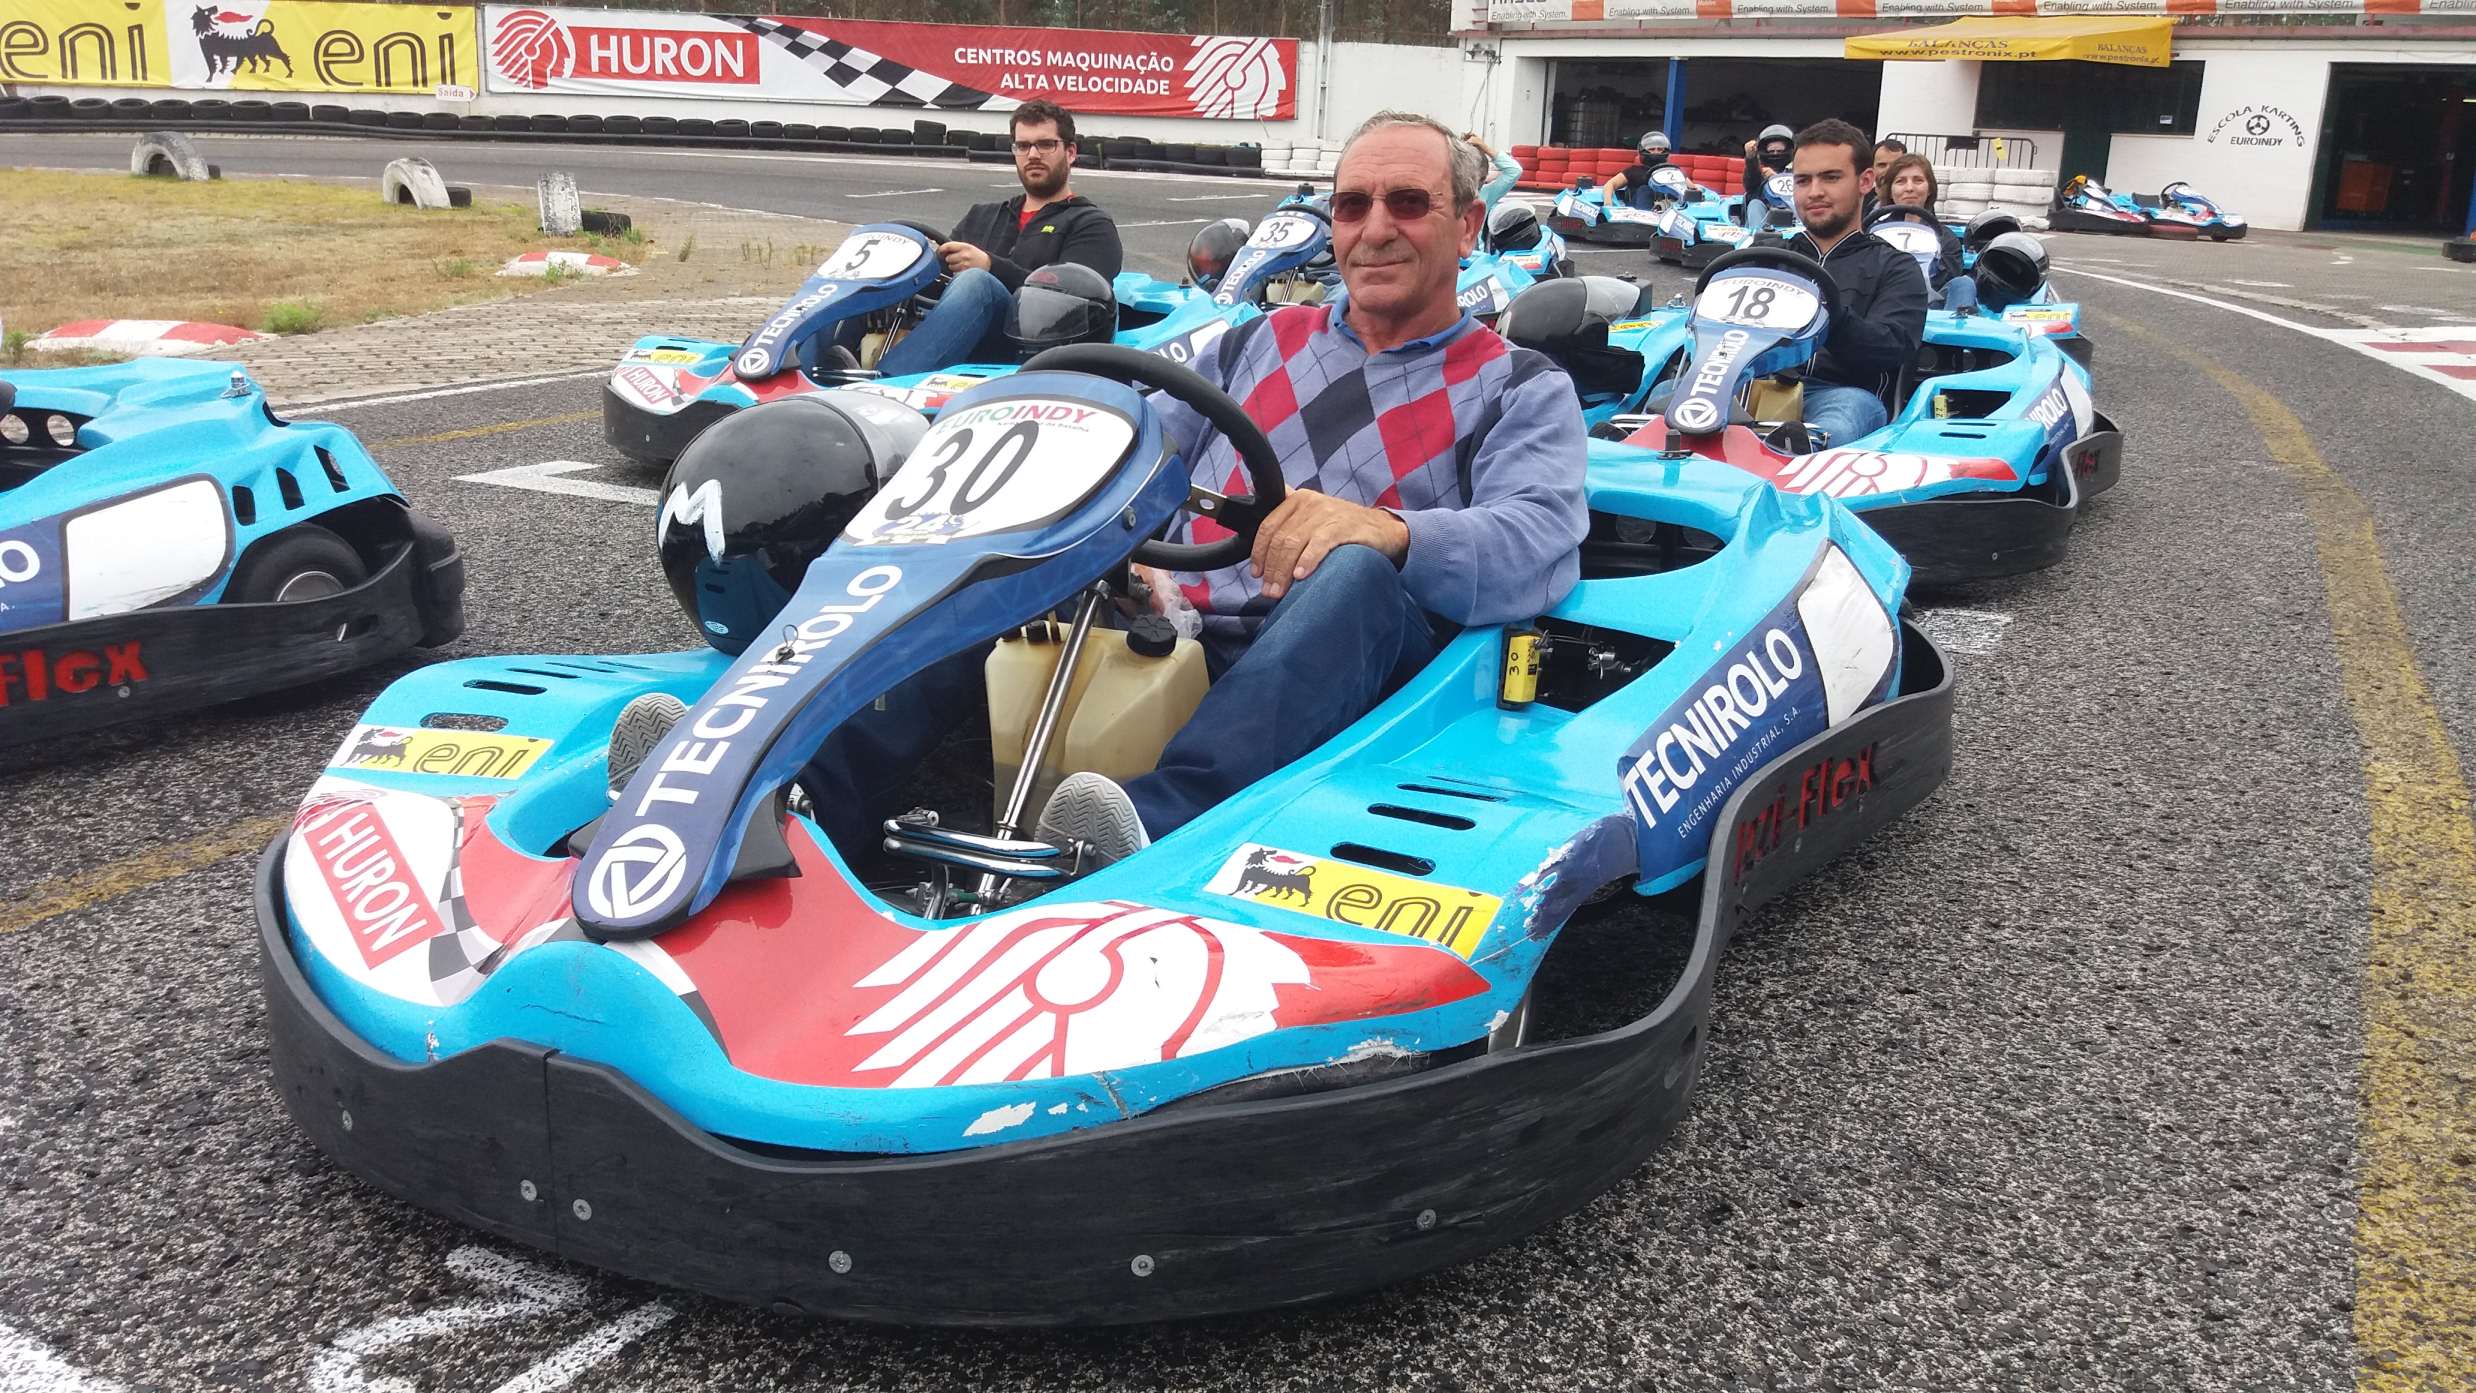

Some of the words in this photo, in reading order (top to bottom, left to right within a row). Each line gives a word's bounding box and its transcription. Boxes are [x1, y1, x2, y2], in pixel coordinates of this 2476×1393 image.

[1609, 8, 1640, 17] Enabling
[1738, 4, 1773, 15] Enabling
[1882, 3, 1922, 13] Enabling
[2044, 1, 2089, 11] Enabling
[2092, 1, 2113, 10] with
[0, 2, 147, 81] eni
[313, 12, 456, 88] eni
[590, 33, 744, 78] HURON
[1880, 48, 2038, 59] www.pestronix.pt
[954, 47, 1042, 66] CENTROS
[1046, 51, 1174, 74] MAQUINAÇÃO
[1000, 73, 1049, 91] ALTA
[1053, 75, 1170, 95] VELOCIDADE
[2208, 106, 2252, 143] ESCOLA
[2261, 105, 2305, 147] KARTING
[2230, 136, 2283, 146] EUROINDY
[1260, 222, 1294, 242] 35
[1897, 233, 1911, 249] 7
[845, 240, 880, 272] 5
[1728, 285, 1775, 320] 18
[627, 367, 670, 398] HURON
[936, 404, 1099, 435] EUROINDY
[884, 420, 1039, 520] 30
[658, 479, 726, 568] M
[635, 565, 903, 817] TECNIROLO
[1623, 628, 1803, 829] TECNIROLO
[412, 738, 539, 778] eni
[1677, 776, 1733, 839] ENGENHARIA
[1732, 724, 1784, 779] INDUSTRIAL,
[1783, 706, 1801, 726] S.A.
[318, 812, 428, 952] HURON
[1326, 883, 1483, 948] eni
